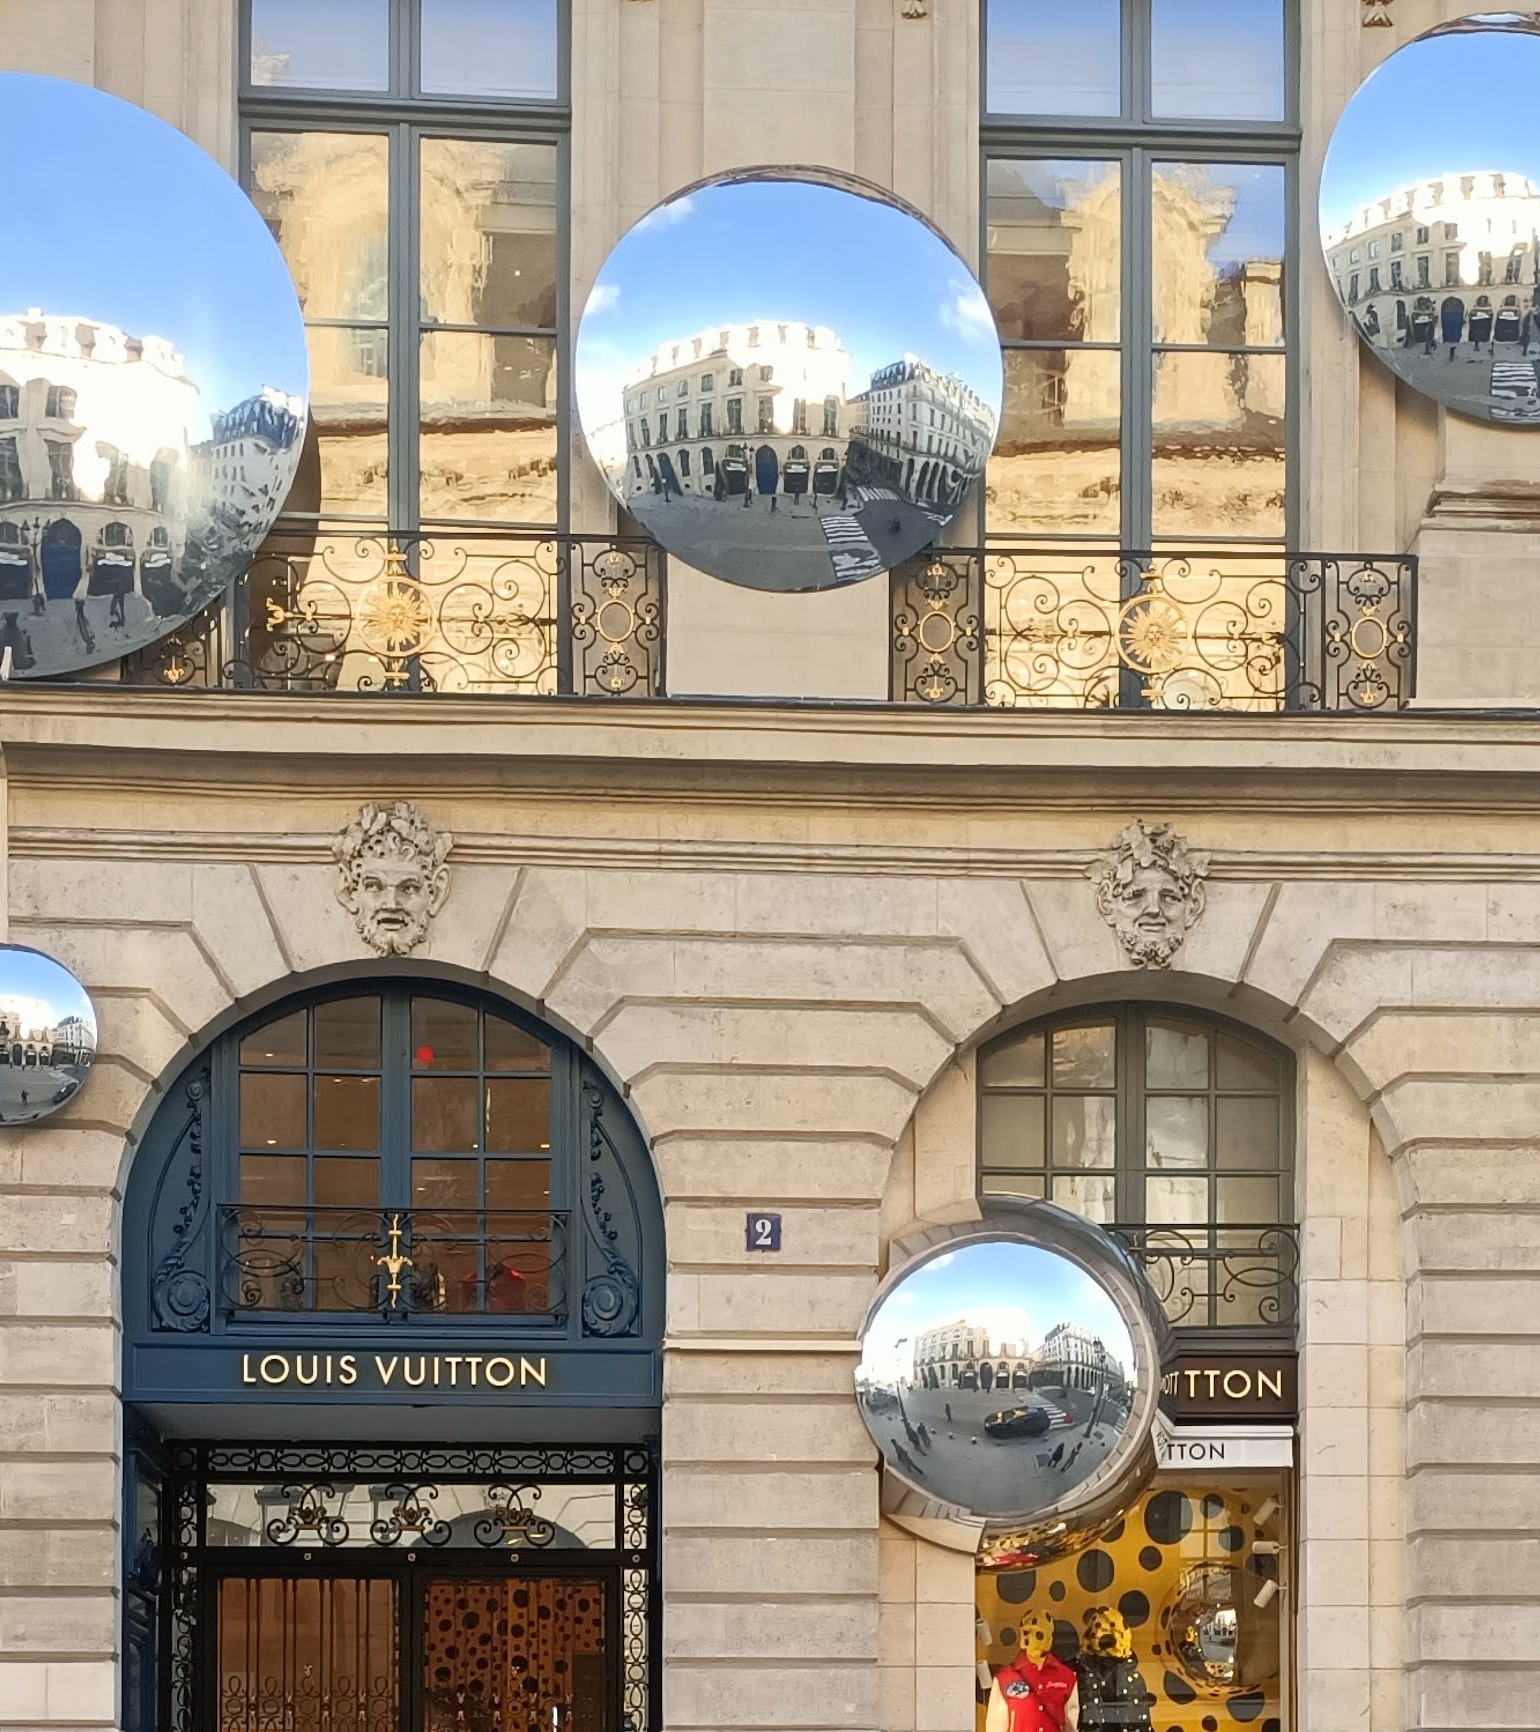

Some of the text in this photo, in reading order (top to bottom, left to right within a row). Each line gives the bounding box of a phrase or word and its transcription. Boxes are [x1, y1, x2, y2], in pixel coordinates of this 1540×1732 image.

[755, 1218, 772, 1246] 2
[242, 1353, 547, 1388] LOUIS VUITTON
[1184, 1369, 1283, 1399] TTON
[1167, 1442, 1226, 1461] TTON
